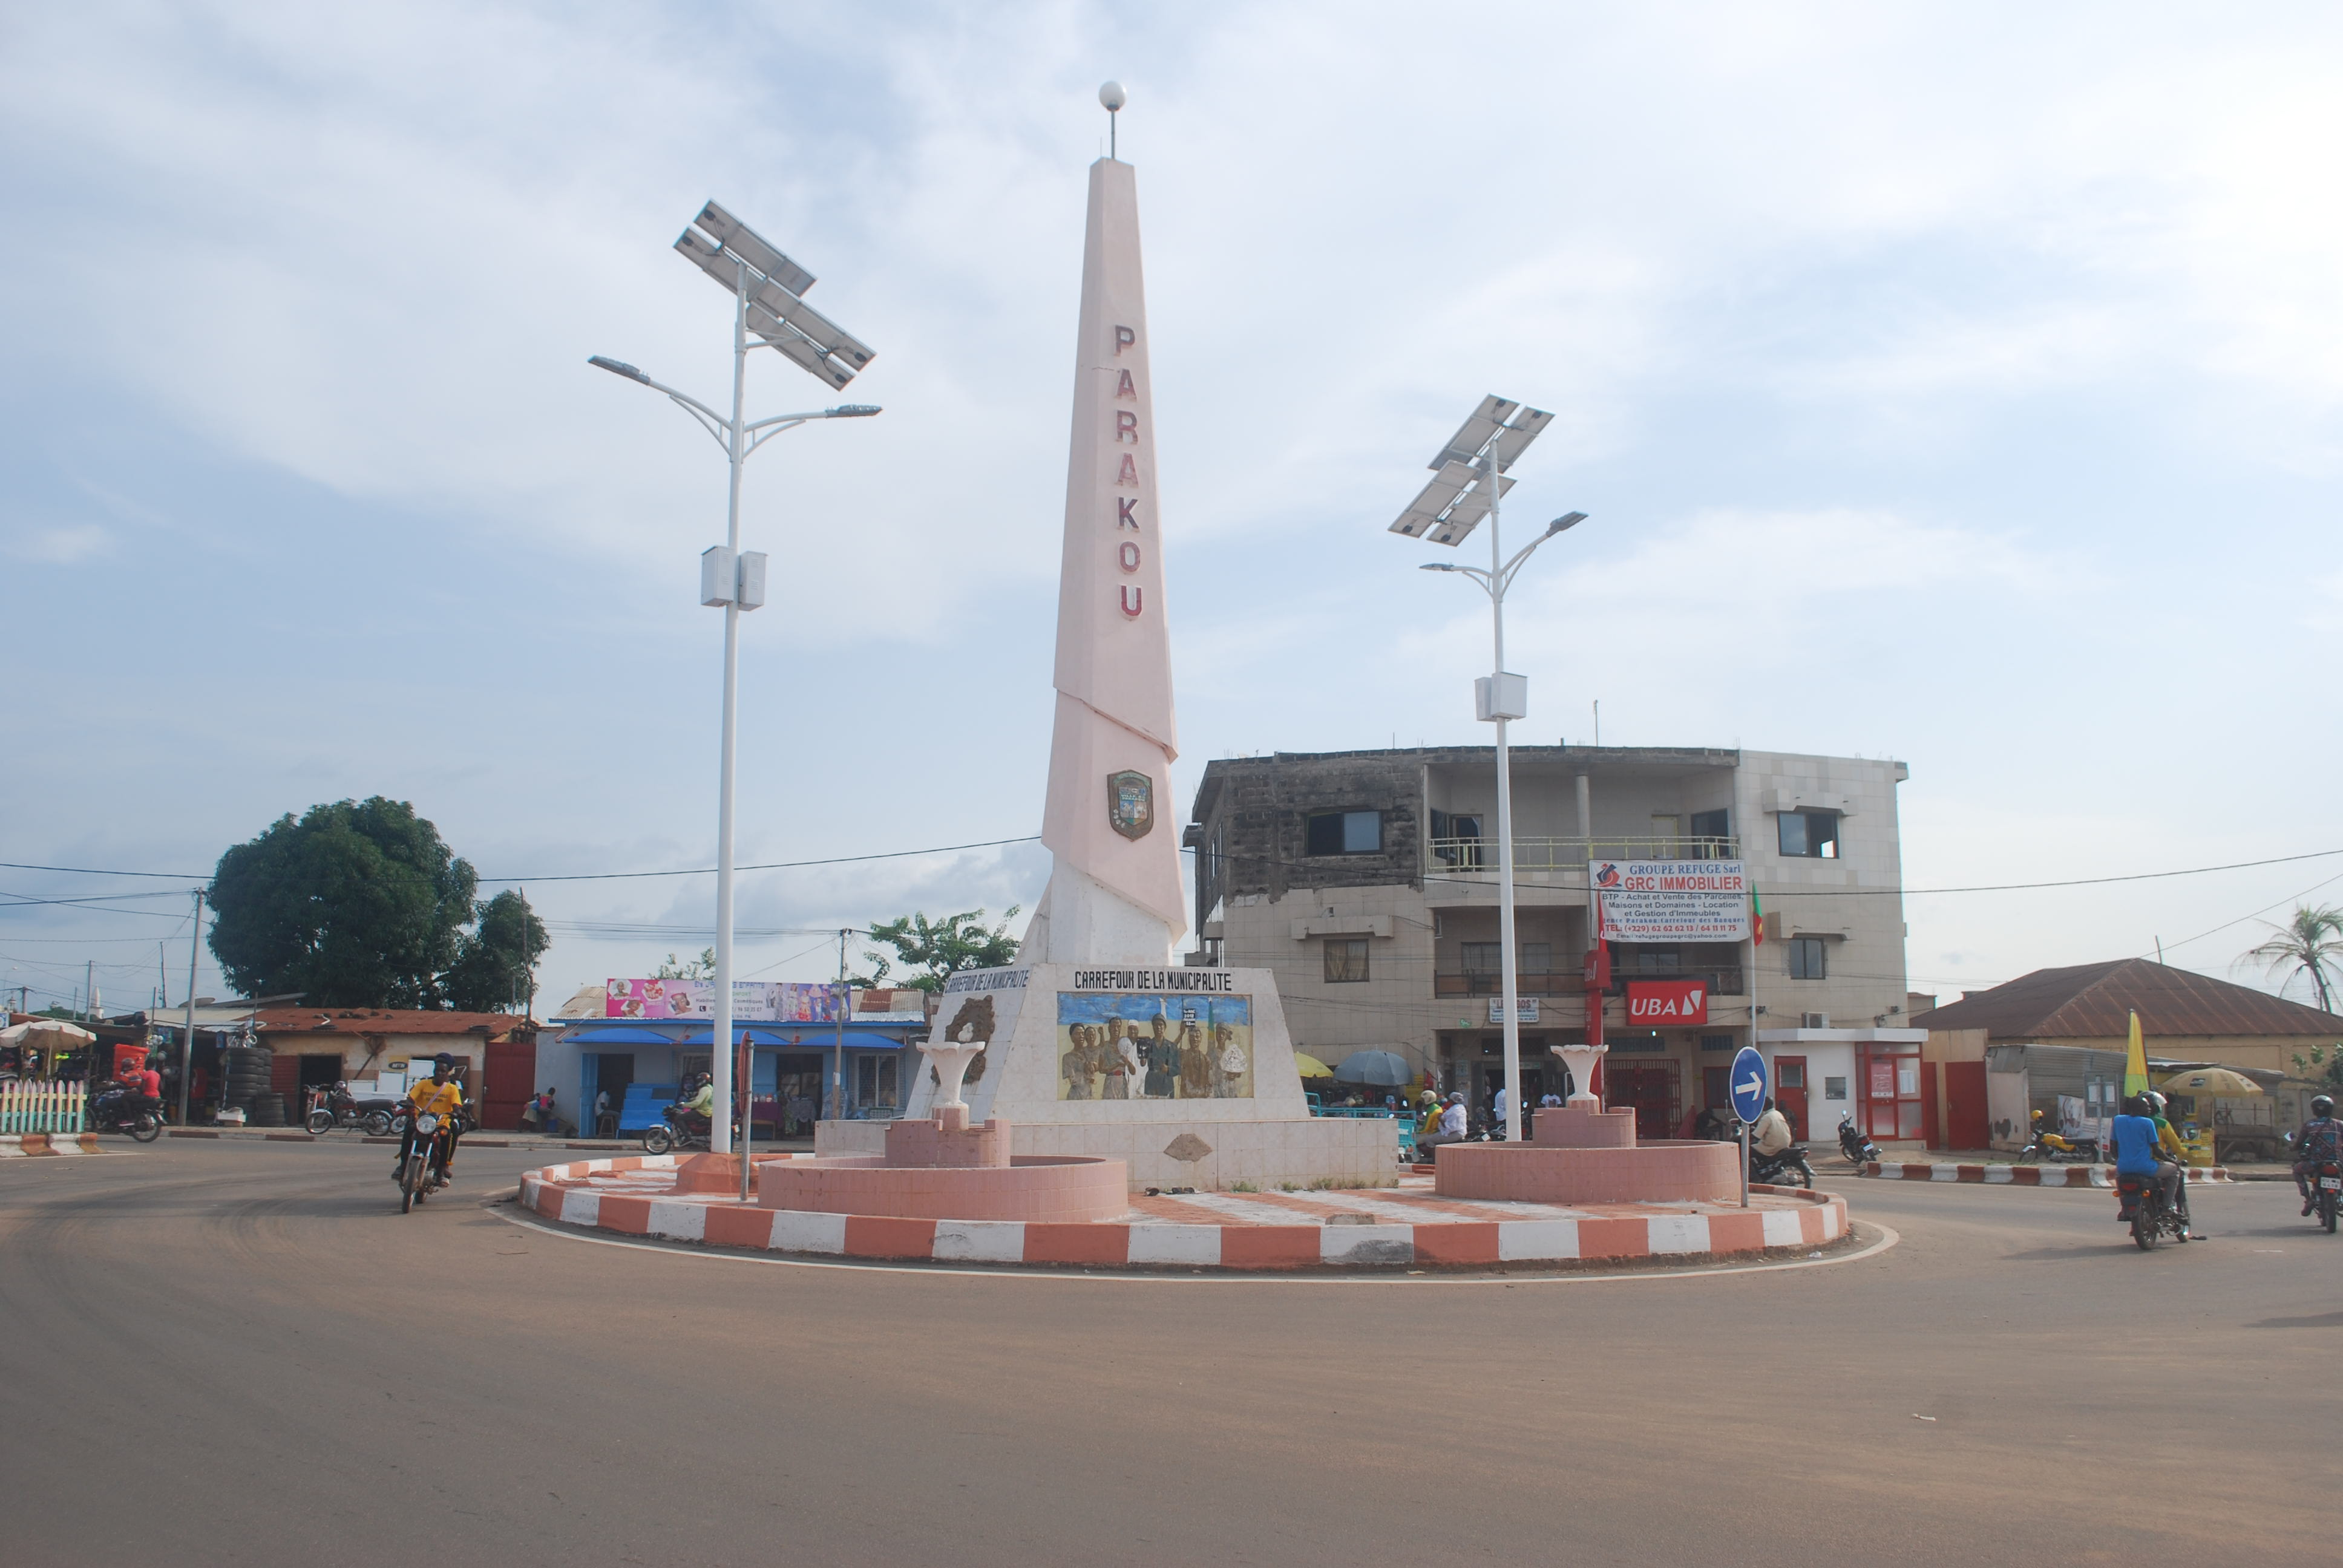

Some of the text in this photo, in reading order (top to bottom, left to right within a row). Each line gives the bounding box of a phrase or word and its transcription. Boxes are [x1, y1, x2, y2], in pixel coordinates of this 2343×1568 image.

[1113, 325, 1142, 619] PARAKOU
[1630, 864, 1741, 875] GROUPE REFUGE Sarl
[1625, 876, 1743, 890] GRC IMMOBILIER
[1075, 971, 1232, 991] CARREFOUR DE LA MUNICIPALITE
[1631, 998, 1677, 1016] UBA
